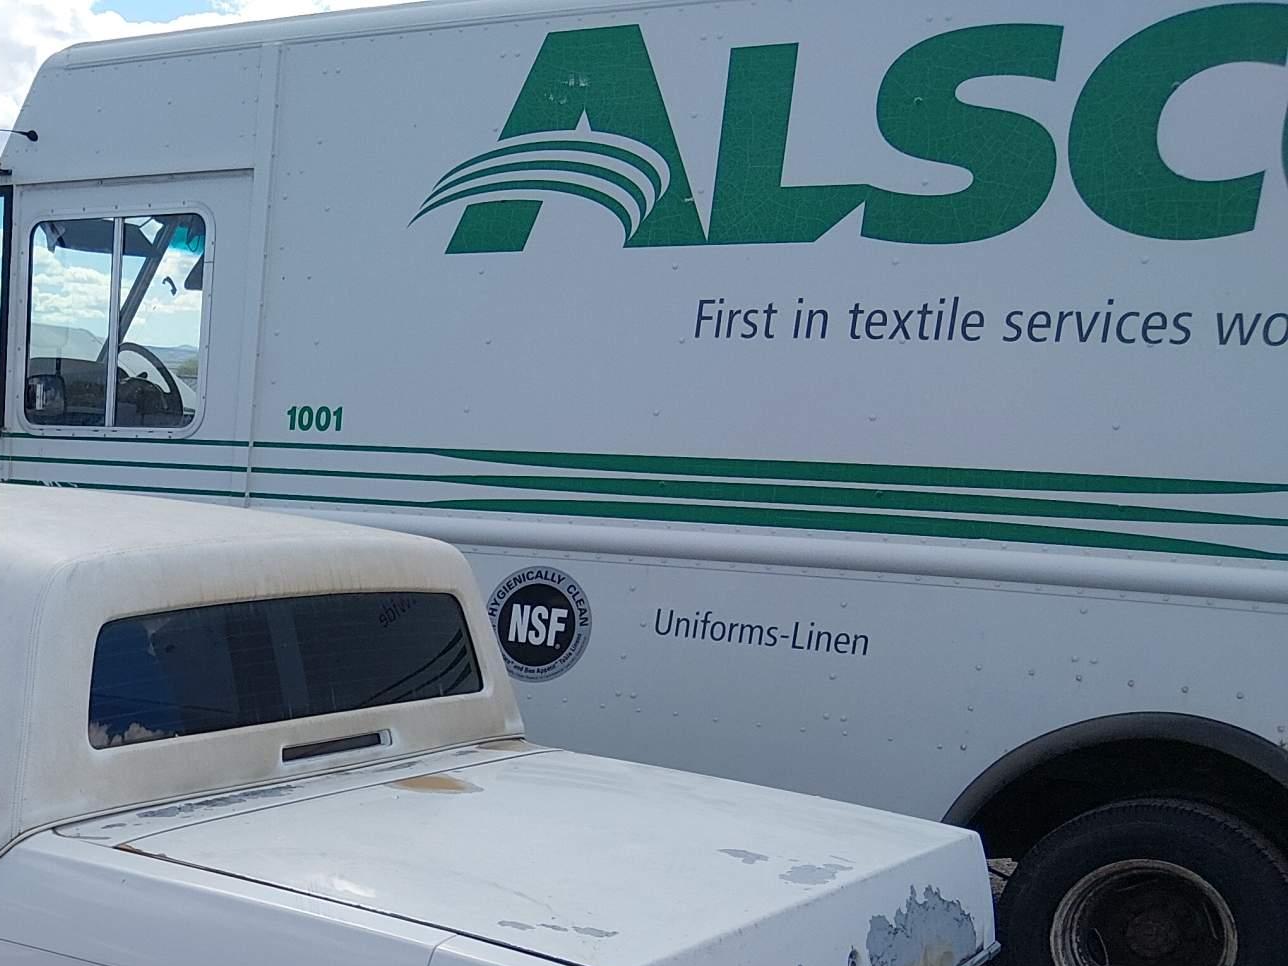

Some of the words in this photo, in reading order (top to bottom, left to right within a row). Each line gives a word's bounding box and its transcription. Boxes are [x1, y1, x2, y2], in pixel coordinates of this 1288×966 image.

[409, 3, 1288, 254] ALSC
[694, 298, 778, 339] First
[793, 298, 829, 339] in
[848, 297, 985, 342] textile
[1002, 299, 1193, 345] services
[286, 405, 344, 432] 1001
[488, 570, 566, 617] HYGIENICALLY
[566, 584, 589, 627] CLEAN
[507, 603, 569, 647] NSF
[654, 608, 869, 656] Uniforms-Linen
